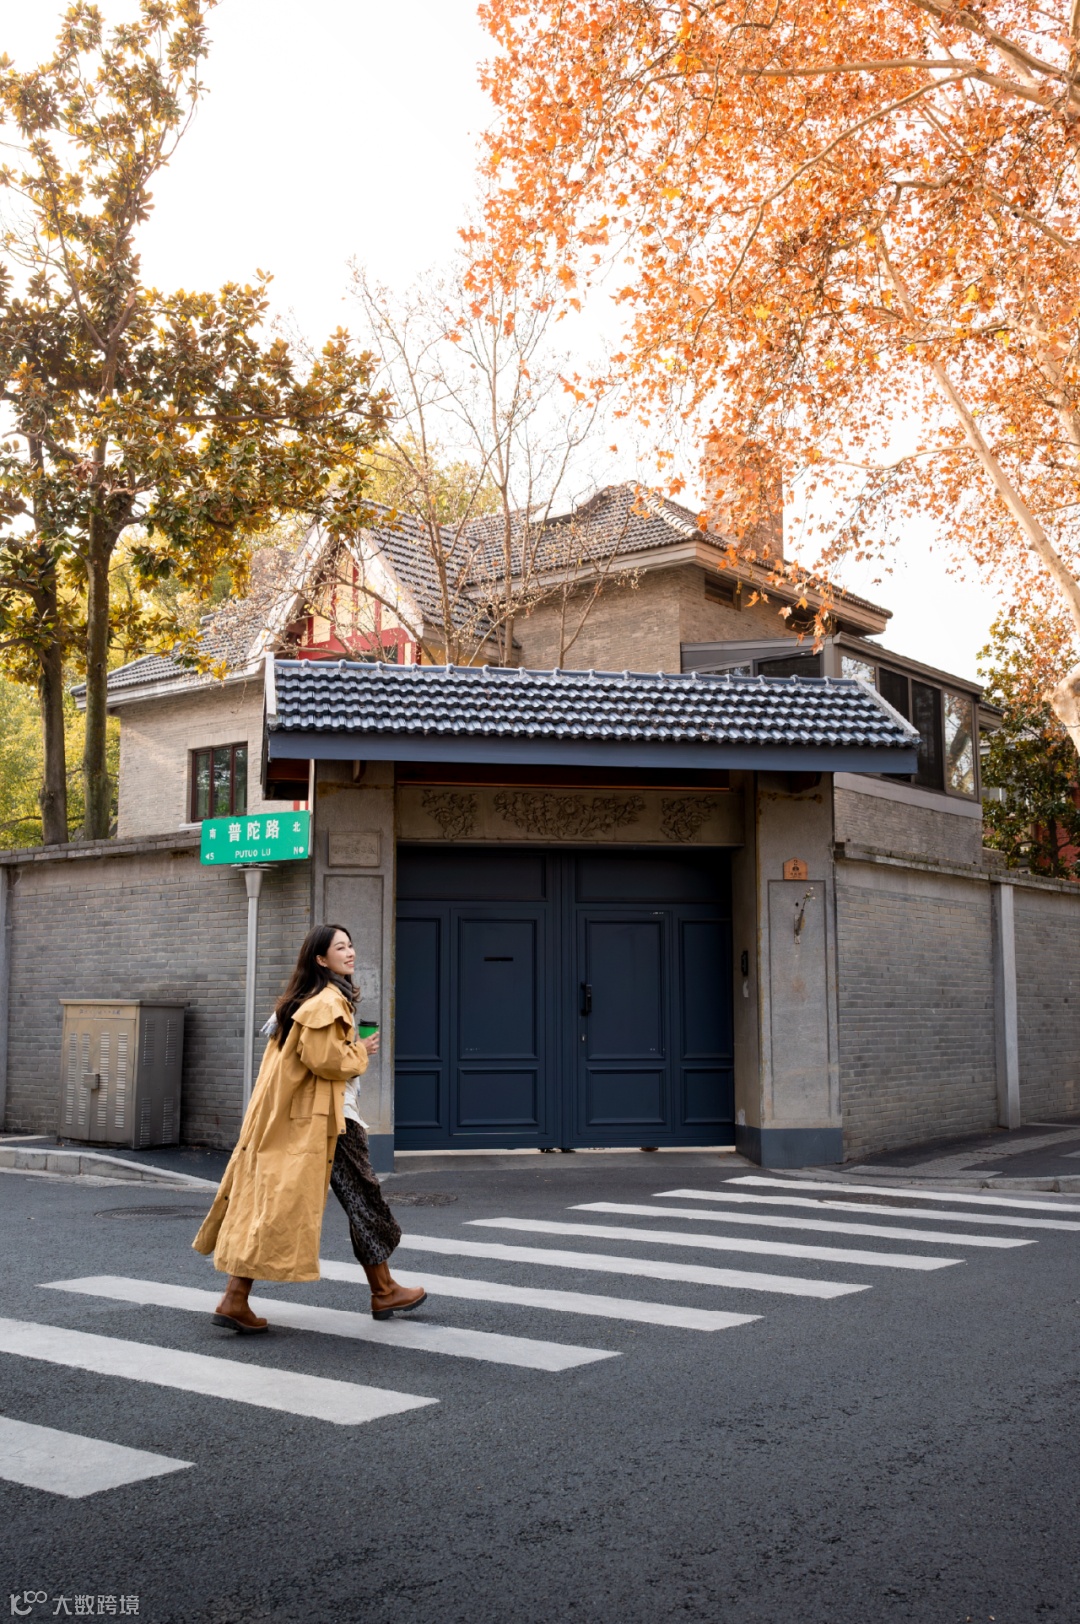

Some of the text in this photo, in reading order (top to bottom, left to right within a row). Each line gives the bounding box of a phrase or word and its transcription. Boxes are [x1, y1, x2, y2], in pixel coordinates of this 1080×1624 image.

[209, 819, 301, 842] 南 普陀路 北
[235, 849, 258, 859] PUTUO
[261, 848, 271, 857] LU
